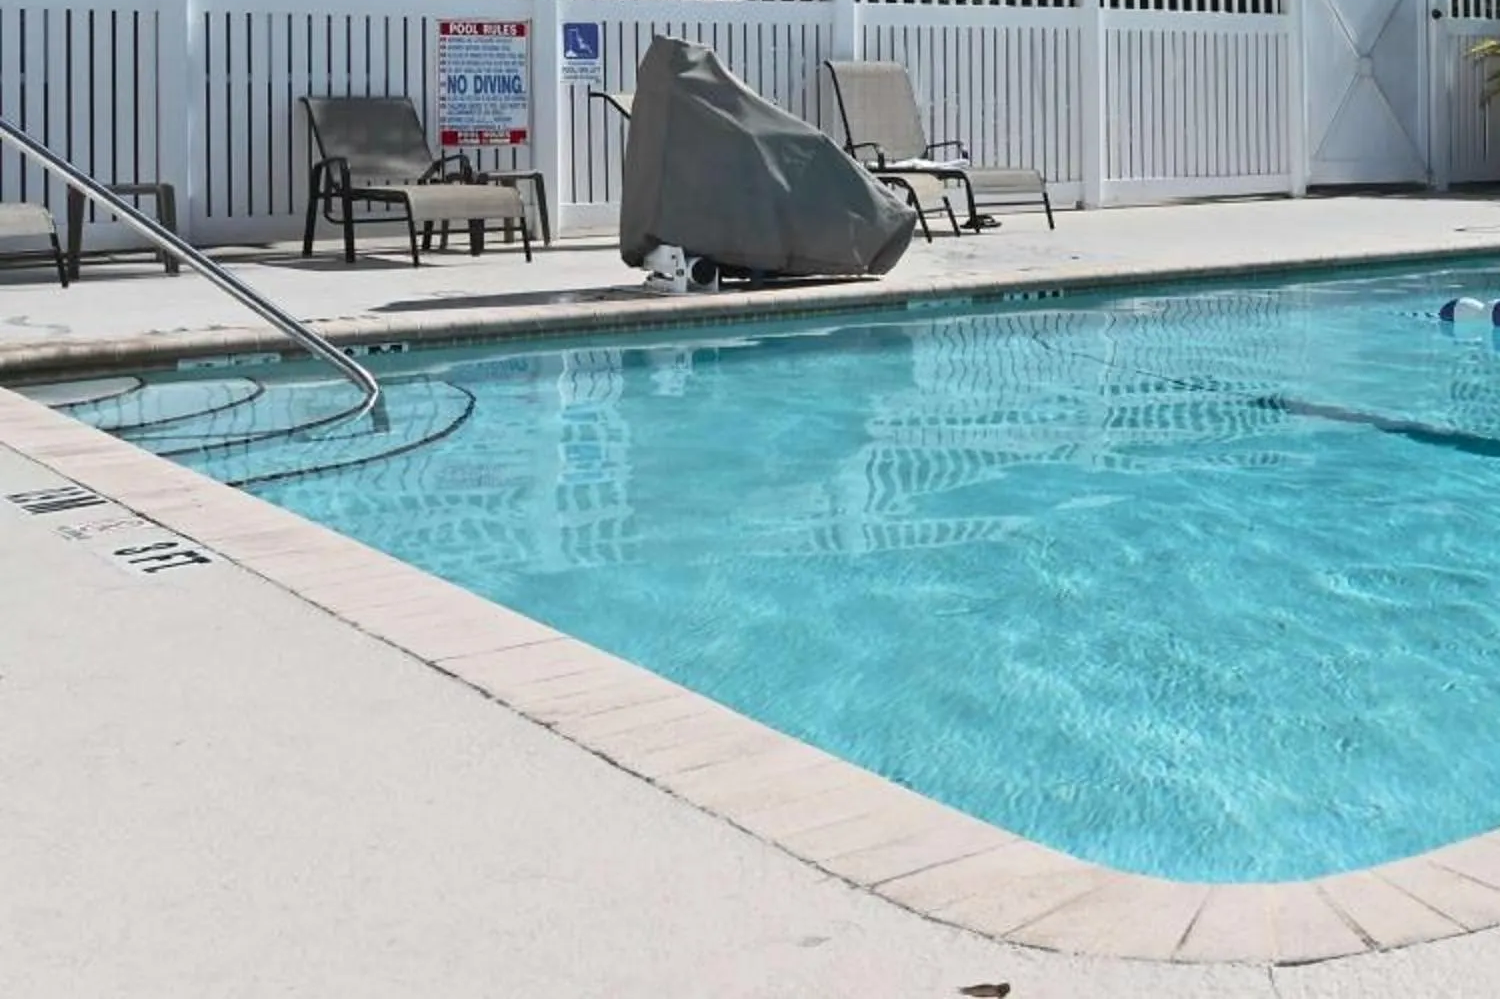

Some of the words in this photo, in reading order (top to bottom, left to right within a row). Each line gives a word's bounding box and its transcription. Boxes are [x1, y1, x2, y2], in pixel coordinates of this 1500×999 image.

[449, 23, 479, 35] POOL
[483, 24, 518, 35] RULES
[447, 74, 467, 94] NO
